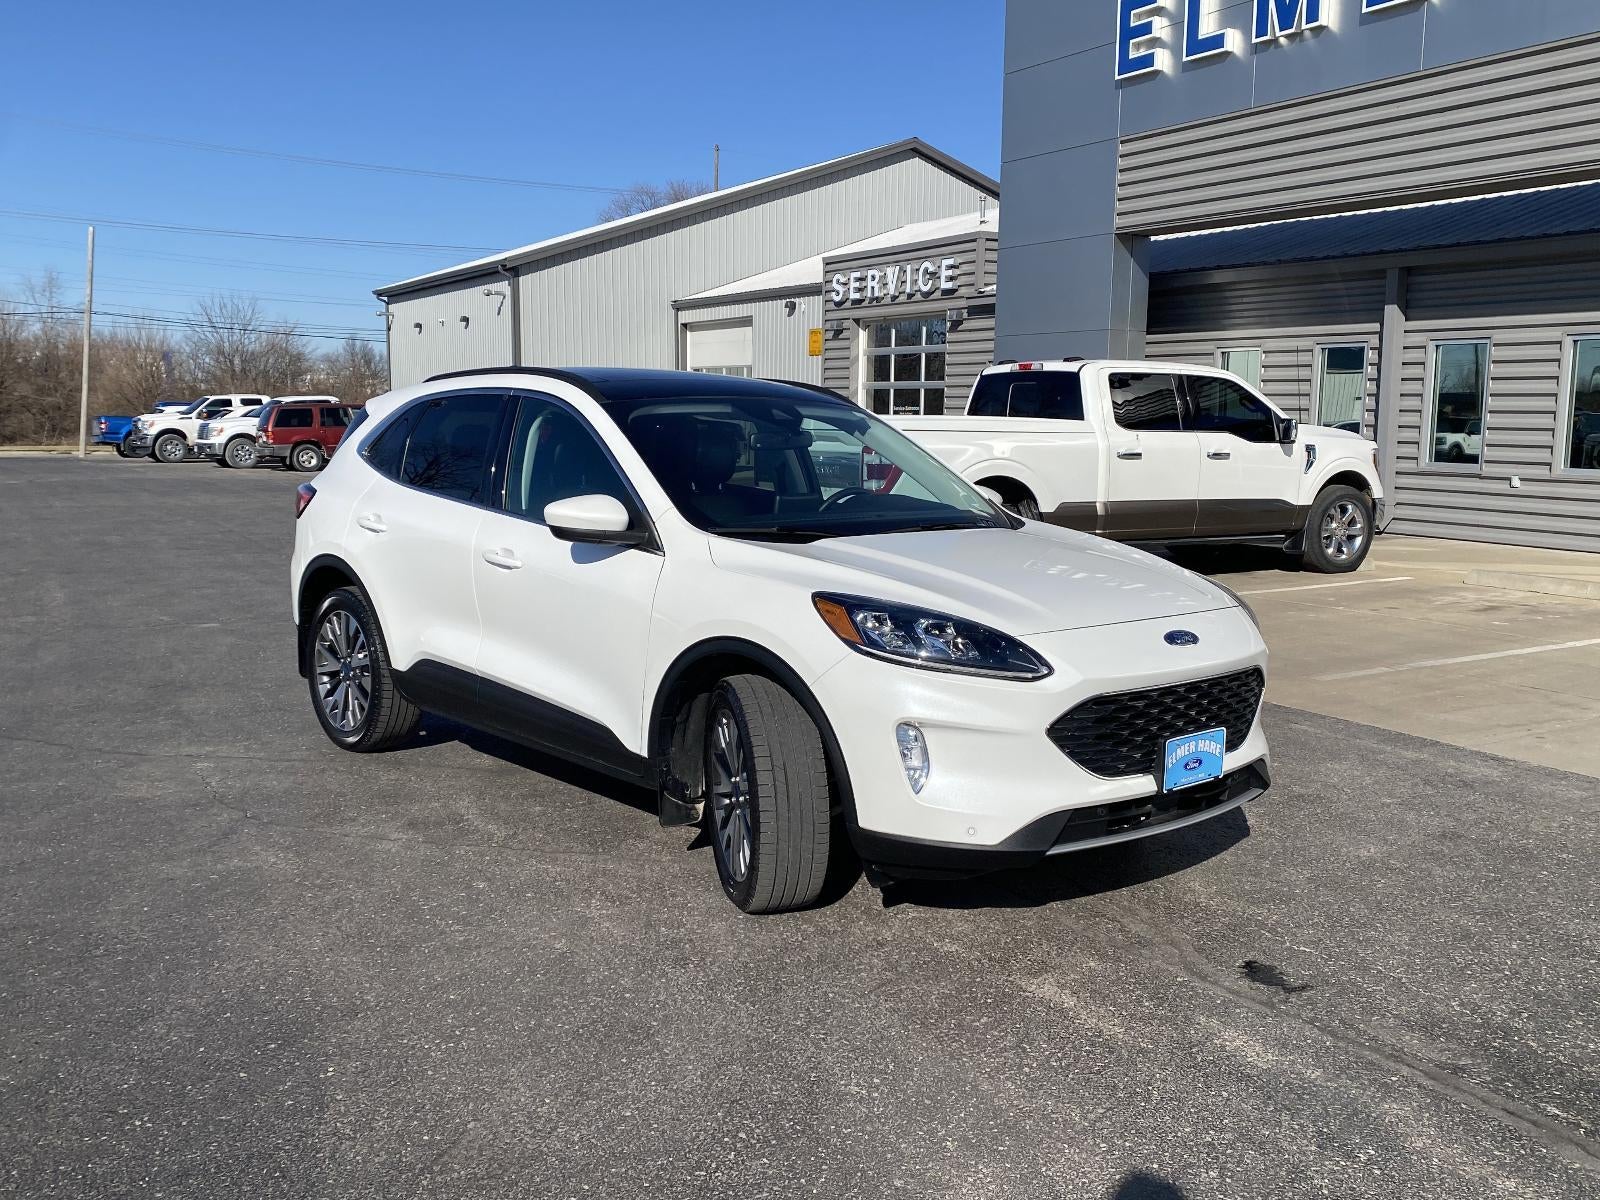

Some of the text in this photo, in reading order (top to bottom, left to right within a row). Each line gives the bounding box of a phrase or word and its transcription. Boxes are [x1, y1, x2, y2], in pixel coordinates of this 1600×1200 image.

[1115, 0, 1428, 80] ELM
[832, 257, 957, 303] SERVICE
[1168, 740, 1222, 768] ELMER HARE
